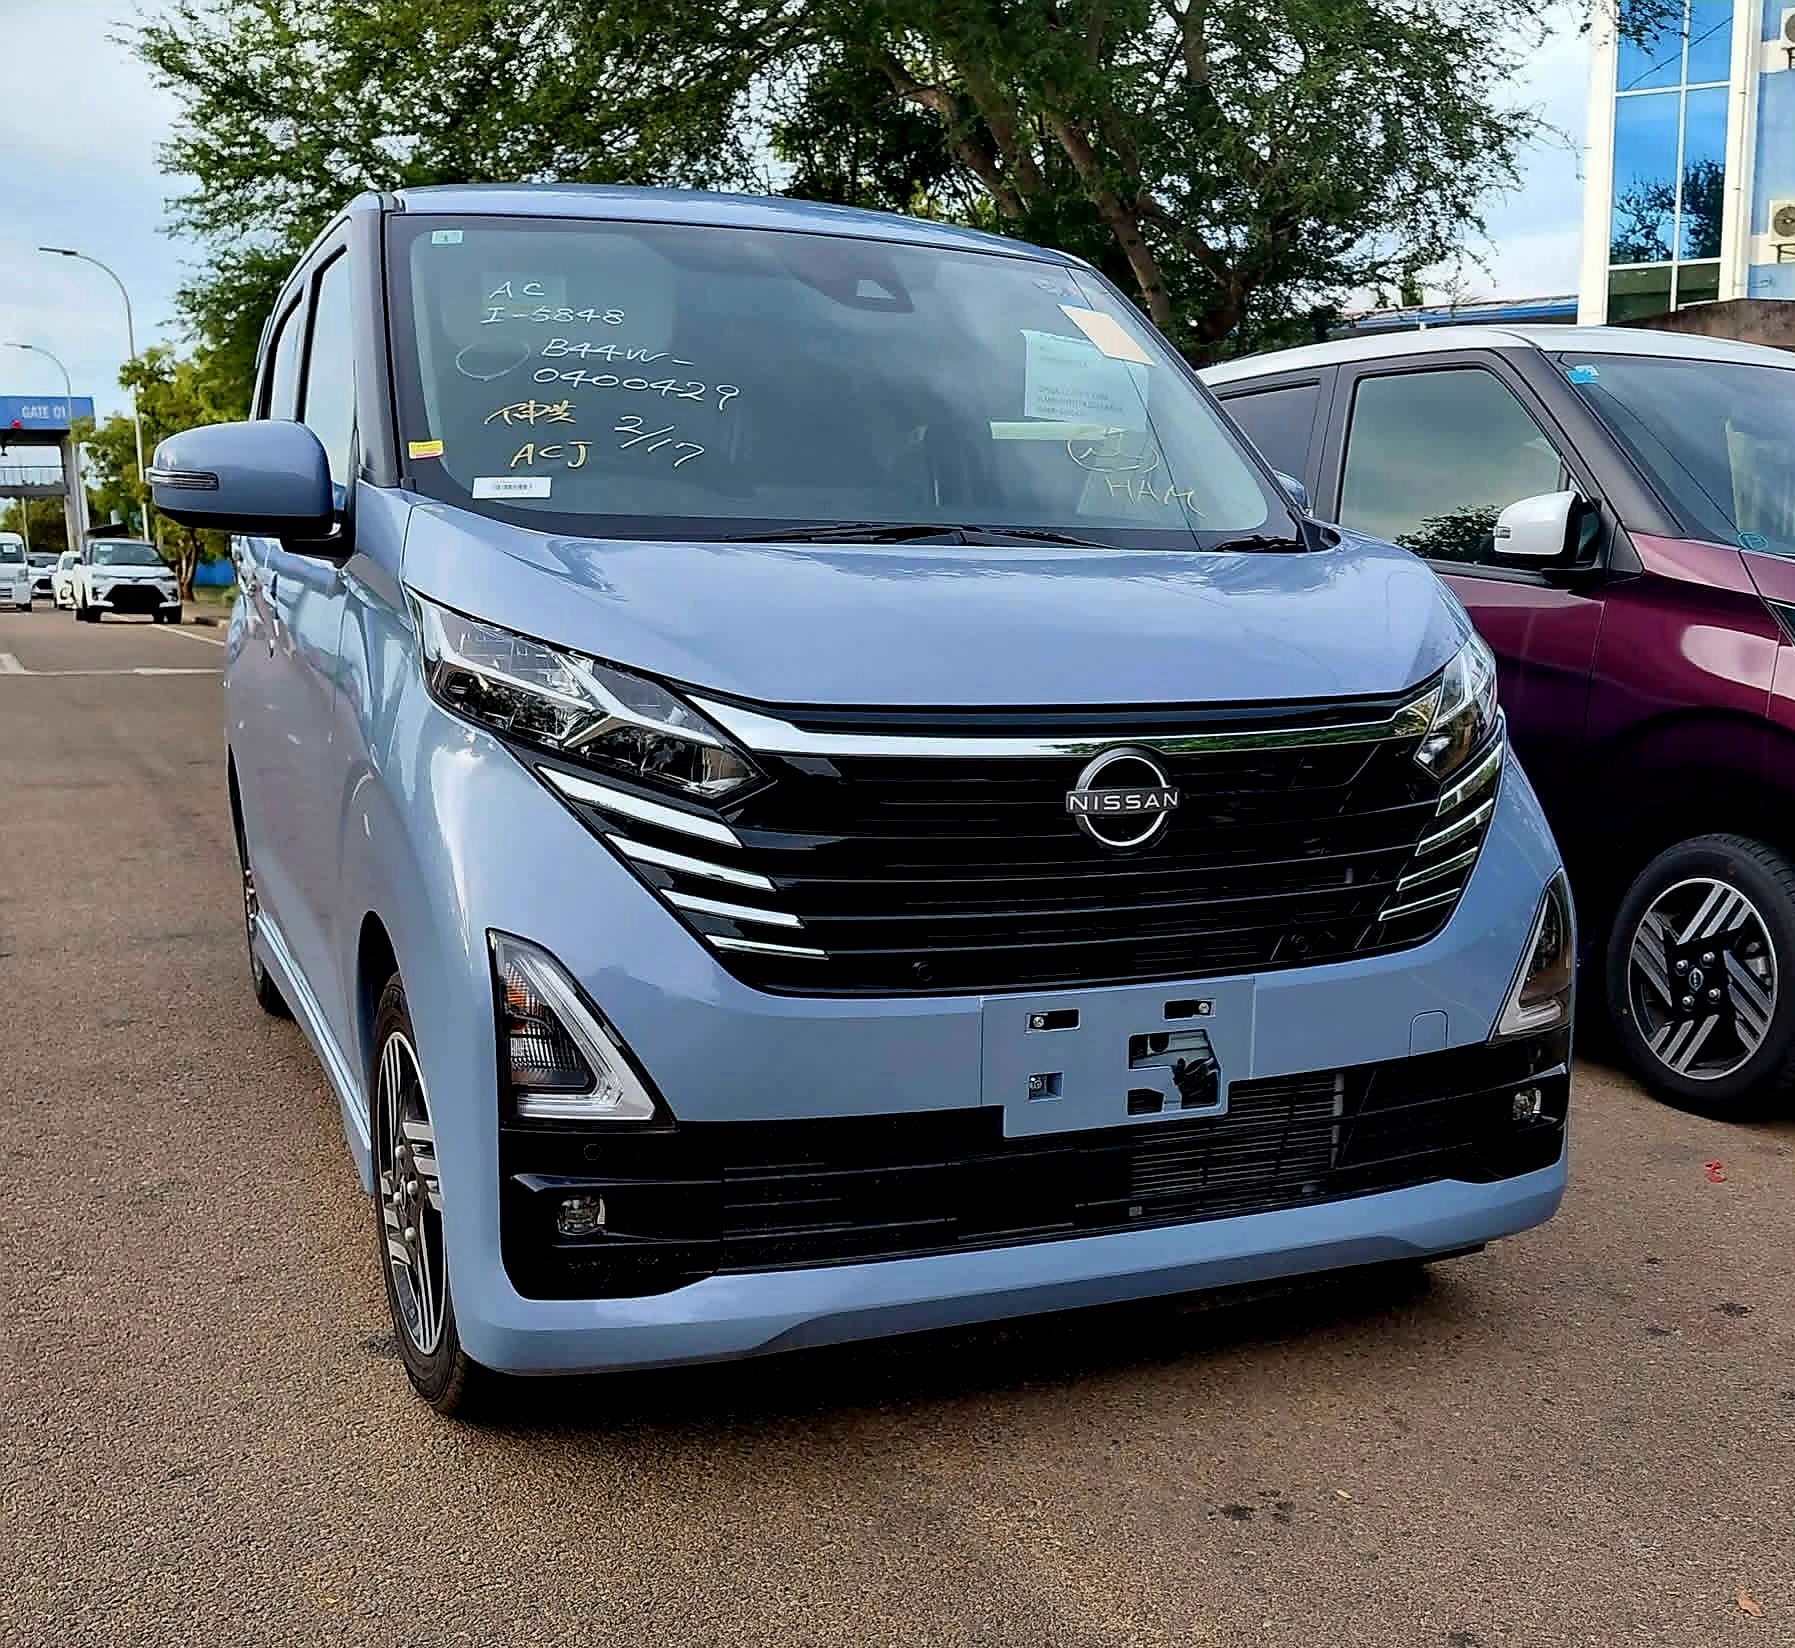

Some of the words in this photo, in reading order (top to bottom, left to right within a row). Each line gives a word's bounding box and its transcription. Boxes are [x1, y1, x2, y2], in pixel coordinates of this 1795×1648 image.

[533, 367, 741, 411] 0400429
[614, 415, 705, 467] 2/17
[1069, 791, 1178, 811] NISSAN
